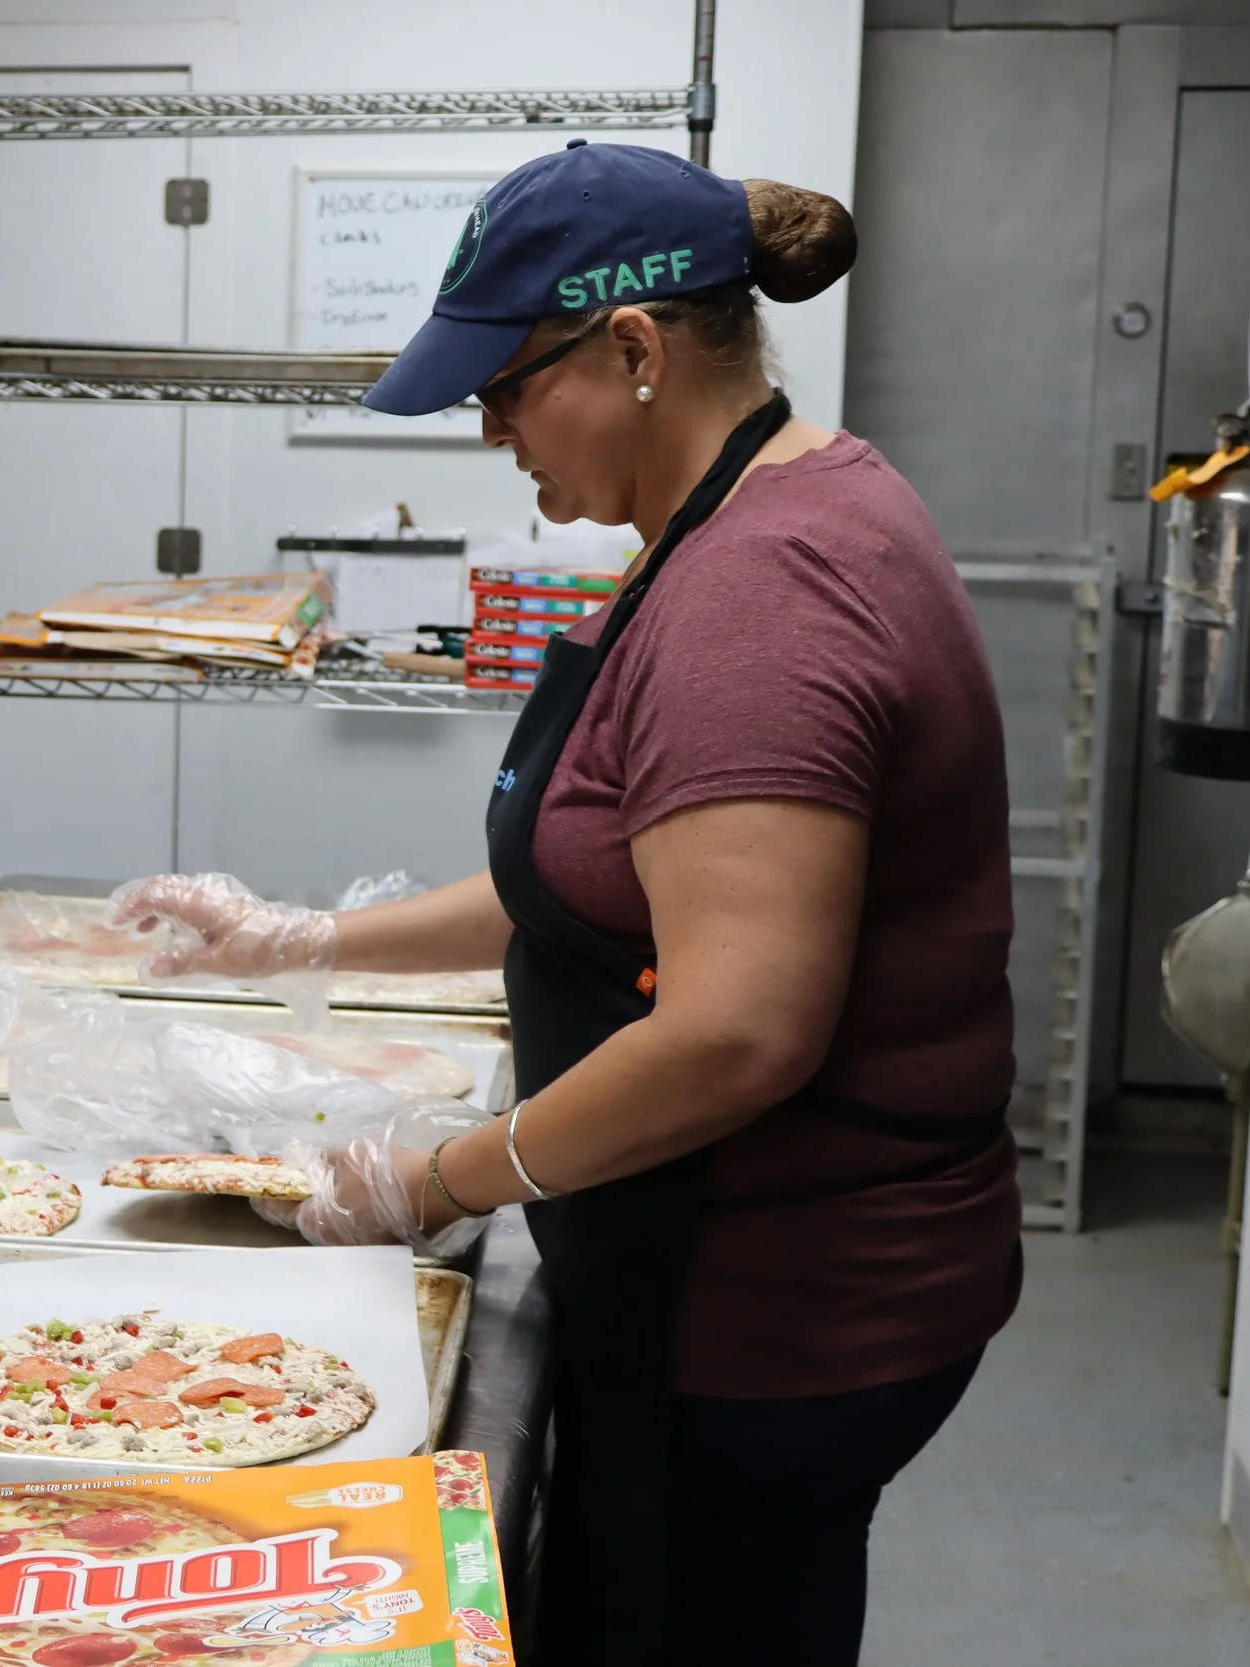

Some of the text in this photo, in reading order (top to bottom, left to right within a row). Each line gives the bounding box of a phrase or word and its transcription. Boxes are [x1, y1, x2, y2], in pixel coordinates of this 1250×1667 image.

[558, 249, 694, 309] STAFF
[495, 768, 516, 792] ch
[183, 1475, 212, 1484] PIZZA
[338, 1486, 386, 1496] CHEESE
[340, 1492, 386, 1502] REAL
[454, 1540, 489, 1584] SUPREME
[372, 1598, 416, 1611] TONY'S
